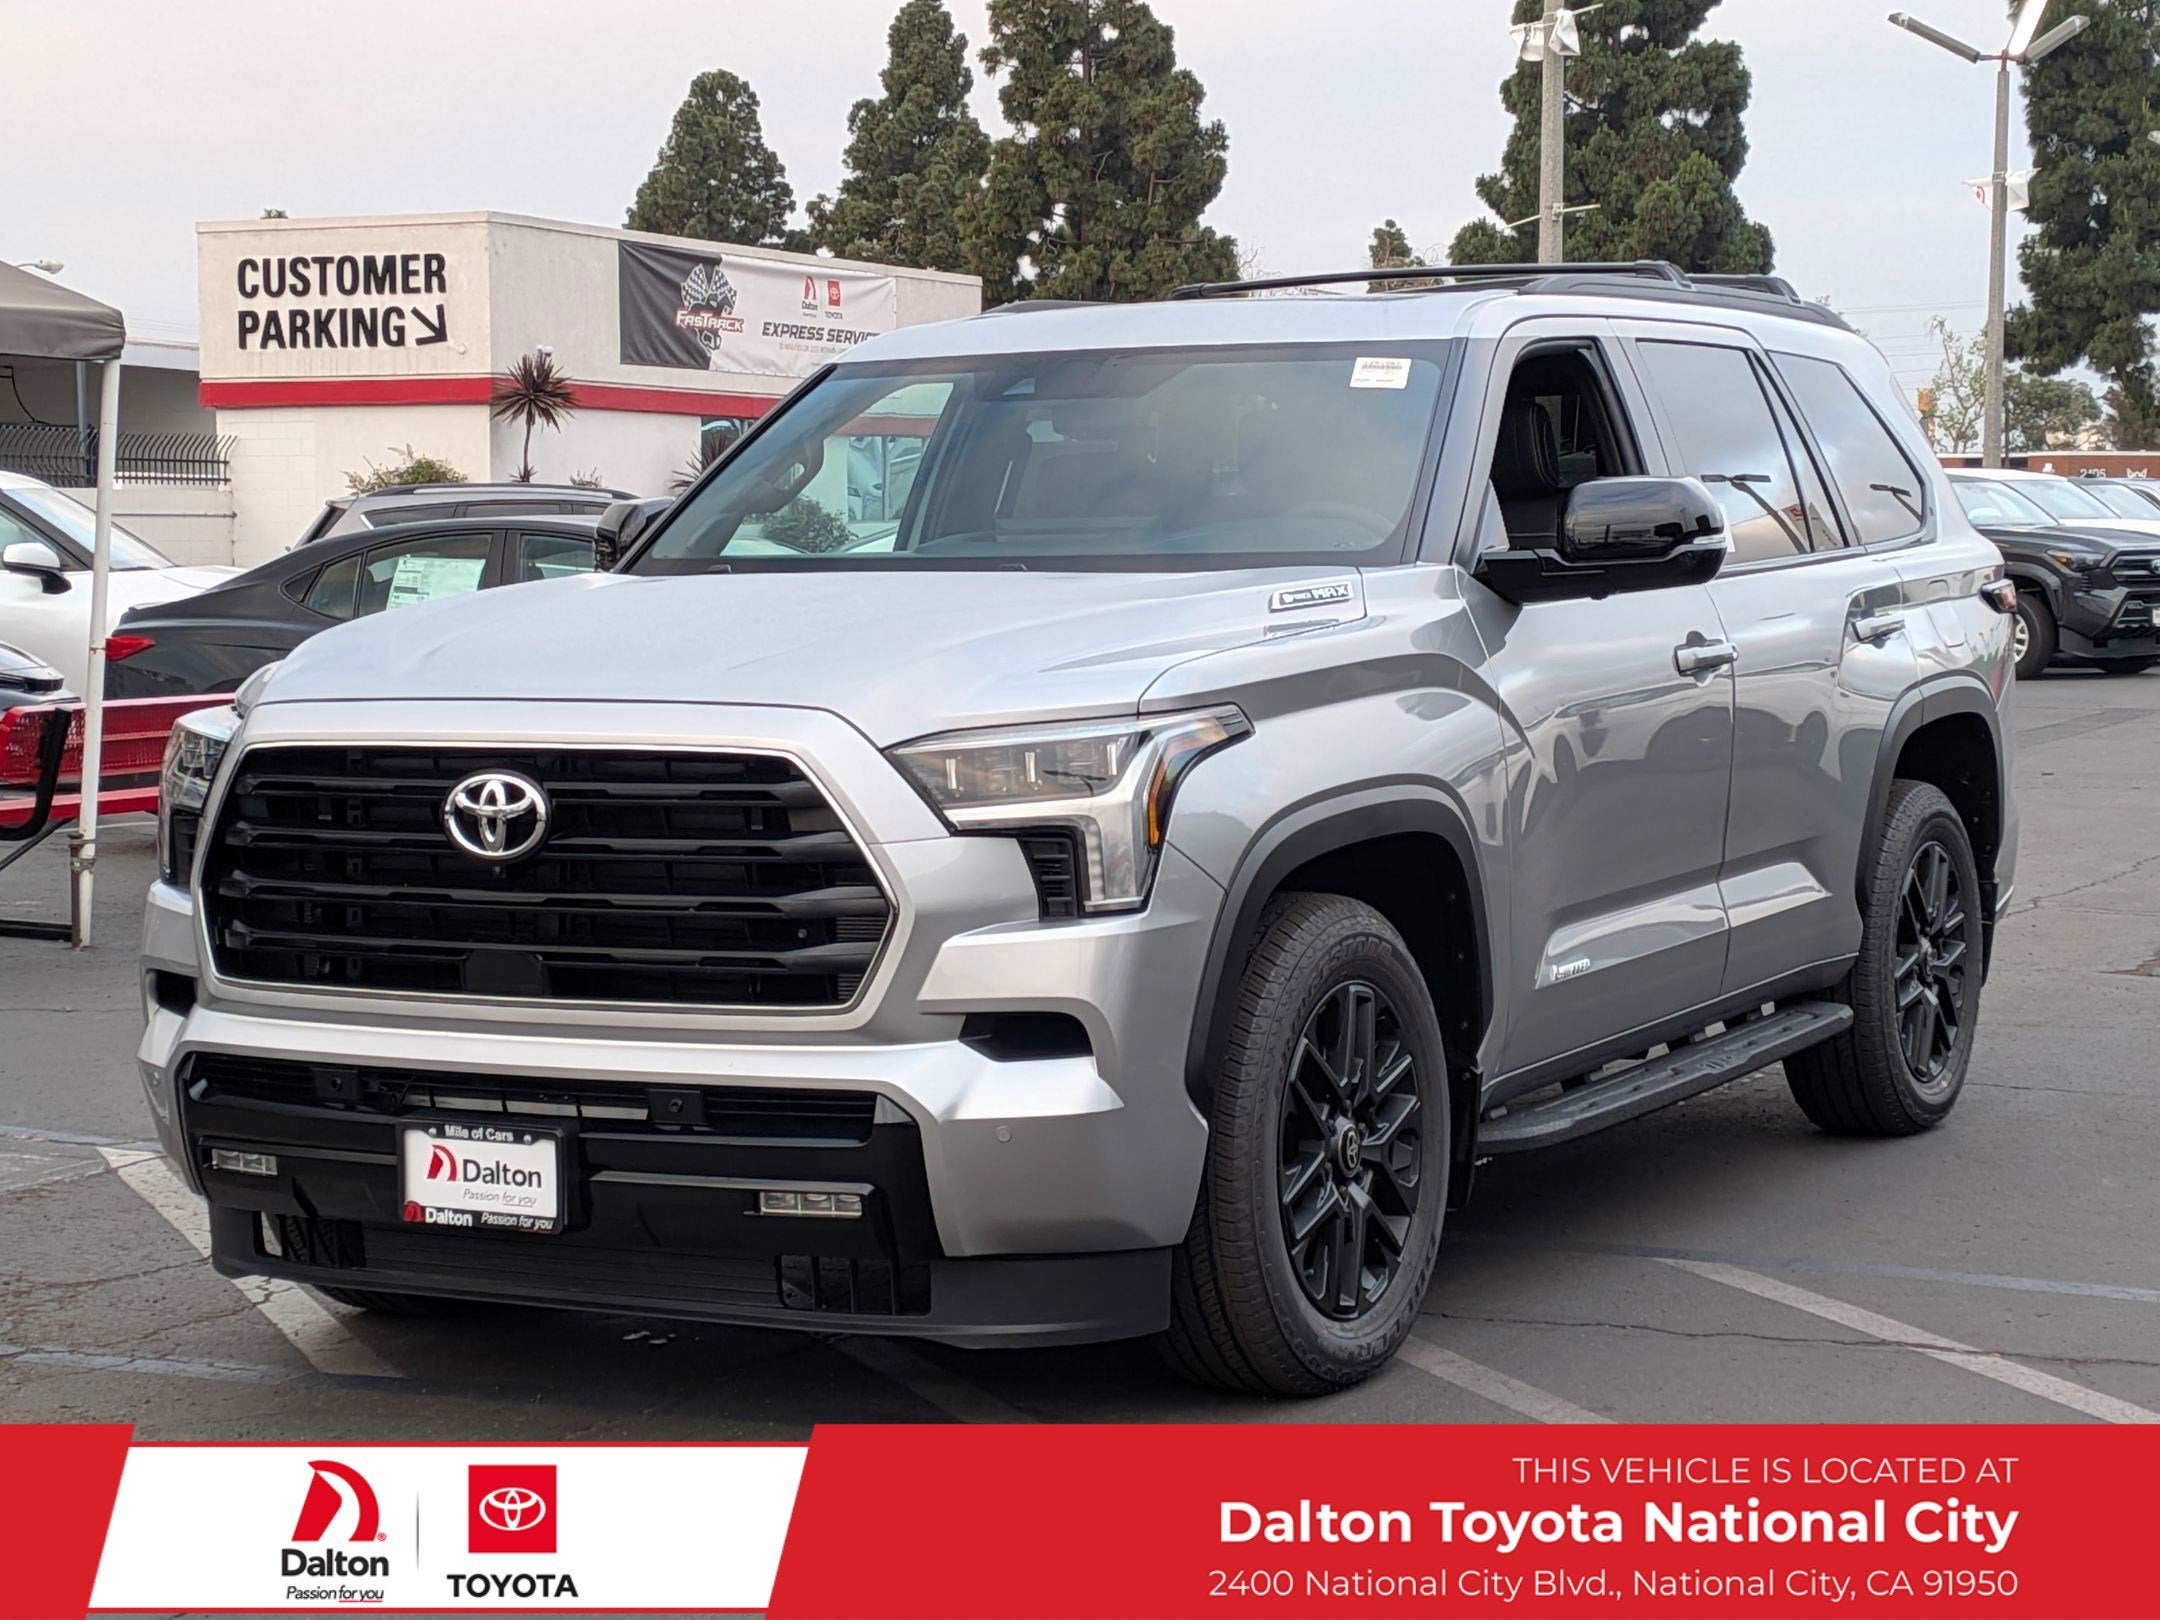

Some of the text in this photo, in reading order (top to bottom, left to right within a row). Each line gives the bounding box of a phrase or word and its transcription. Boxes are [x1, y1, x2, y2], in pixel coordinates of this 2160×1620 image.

[237, 253, 447, 299] CUSTOMER
[237, 306, 406, 350] PARKING
[761, 321, 881, 344] EXPRESS SERVIC
[444, 1125, 514, 1142] Mile of Cars
[463, 1158, 542, 1188] Dalton
[463, 1188, 537, 1206] Passion for you
[425, 1207, 554, 1230] Dalton Passion for you
